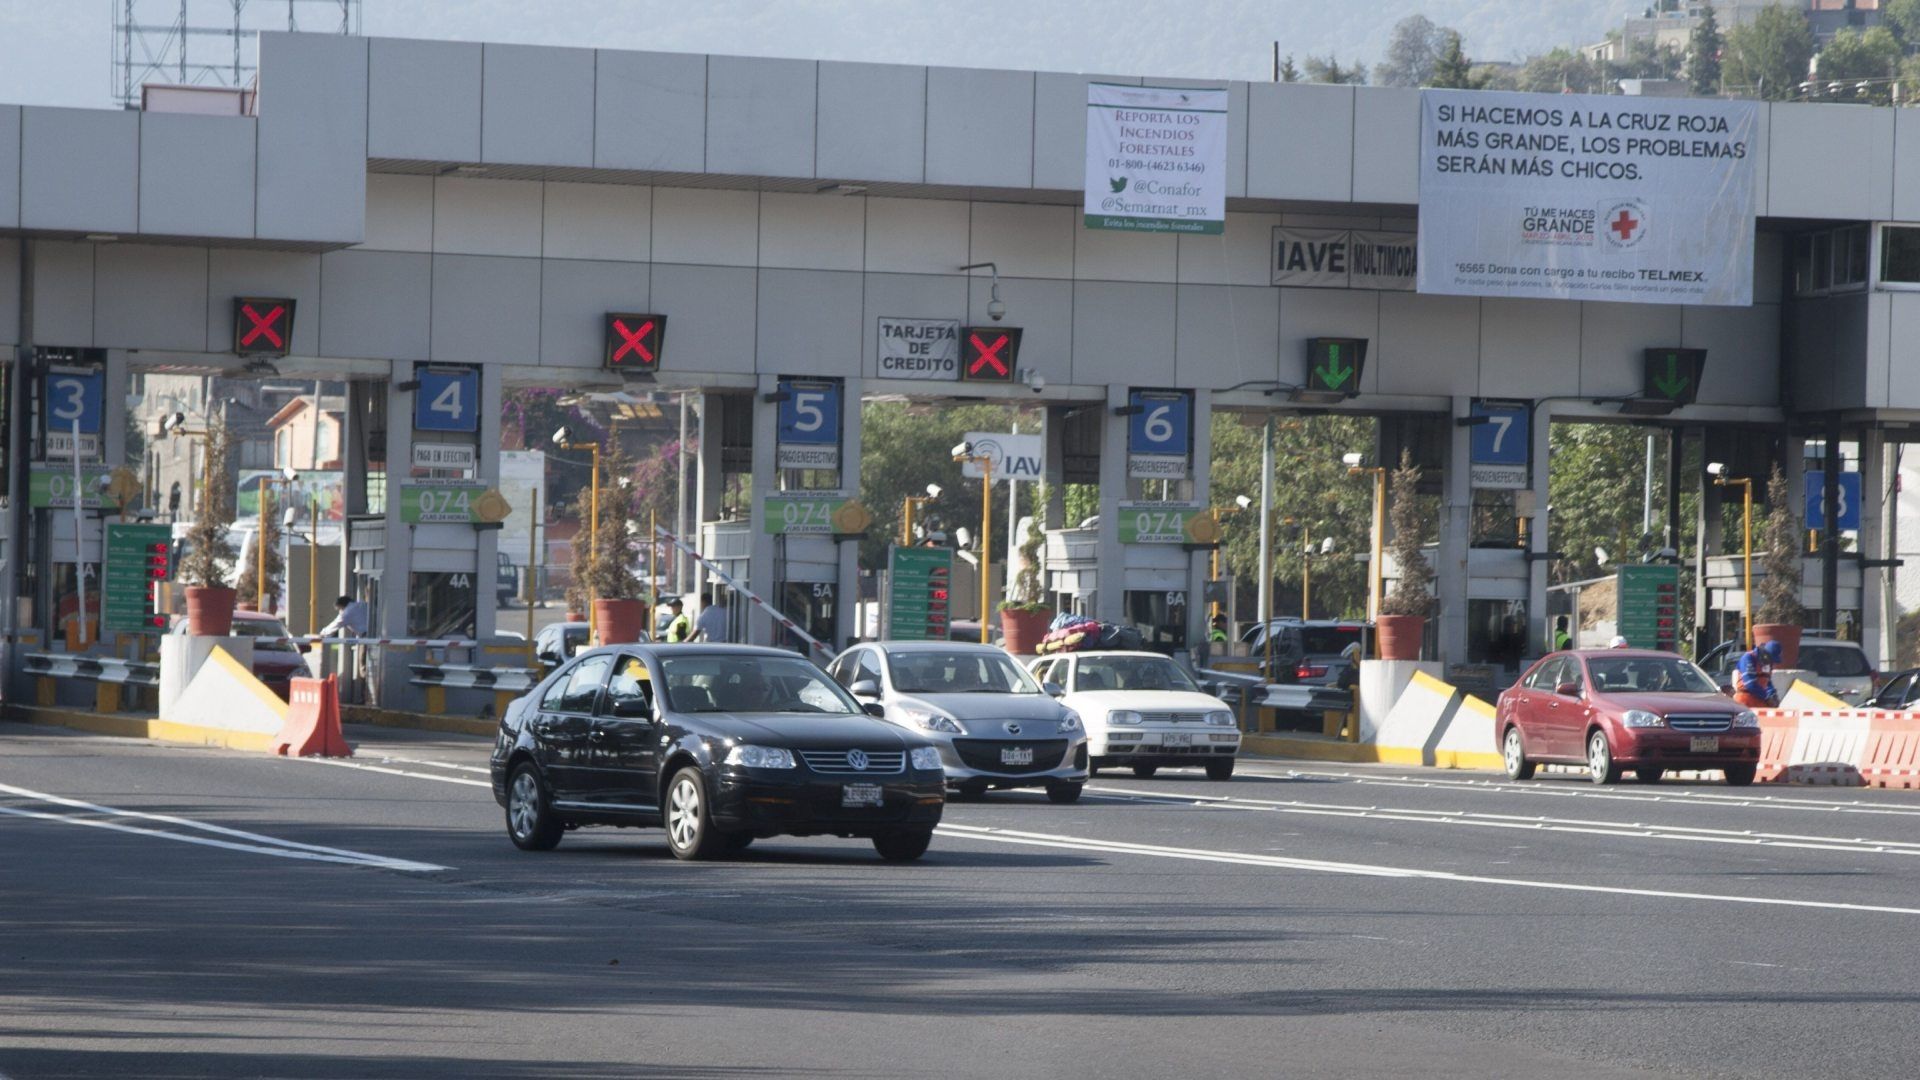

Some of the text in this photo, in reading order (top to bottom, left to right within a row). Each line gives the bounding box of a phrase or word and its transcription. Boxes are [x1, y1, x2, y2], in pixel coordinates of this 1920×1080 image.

[1115, 110, 1200, 126] REPORTA LOS
[1438, 105, 1729, 133] SI HACEMOS A LA CRUZ ROJA
[1119, 126, 1195, 141] INCENDIOS
[1119, 141, 1195, 157] FORESTALES
[1437, 128, 1746, 159] MÁS GRANDE, LOS PROBLEMAS
[1437, 154, 1643, 181] SERÁN MÁS CHICOS.
[1133, 180, 1202, 197] @Conafor
[1101, 197, 1207, 217] @Semarnat_mx
[1523, 206, 1539, 217] TÚ
[1541, 208, 1557, 218] ME
[1559, 209, 1596, 220] HACES
[1523, 218, 1595, 234] GRANDE
[1277, 241, 1346, 273] IAVE
[1488, 264, 1517, 275] Dona
[1520, 267, 1541, 276] con
[1543, 267, 1575, 279] cargo
[1577, 269, 1585, 277] a
[1587, 268, 1598, 278] tu
[1601, 269, 1636, 280] recibo
[882, 325, 957, 340] TARJETA
[909, 342, 930, 355] DE
[883, 357, 954, 371] CREDITO
[54, 379, 85, 420] 3
[430, 380, 463, 420] 4
[794, 393, 825, 432] 5
[1144, 405, 1173, 443] 6
[1489, 416, 1513, 453] 7
[416, 449, 471, 463] PAGO EN EFECTIVO
[419, 491, 470, 513] 074
[783, 502, 832, 525] 074
[1136, 512, 1184, 534] 074
[449, 573, 471, 589] 4A
[813, 583, 833, 598] 5A
[1165, 591, 1186, 606] 6A
